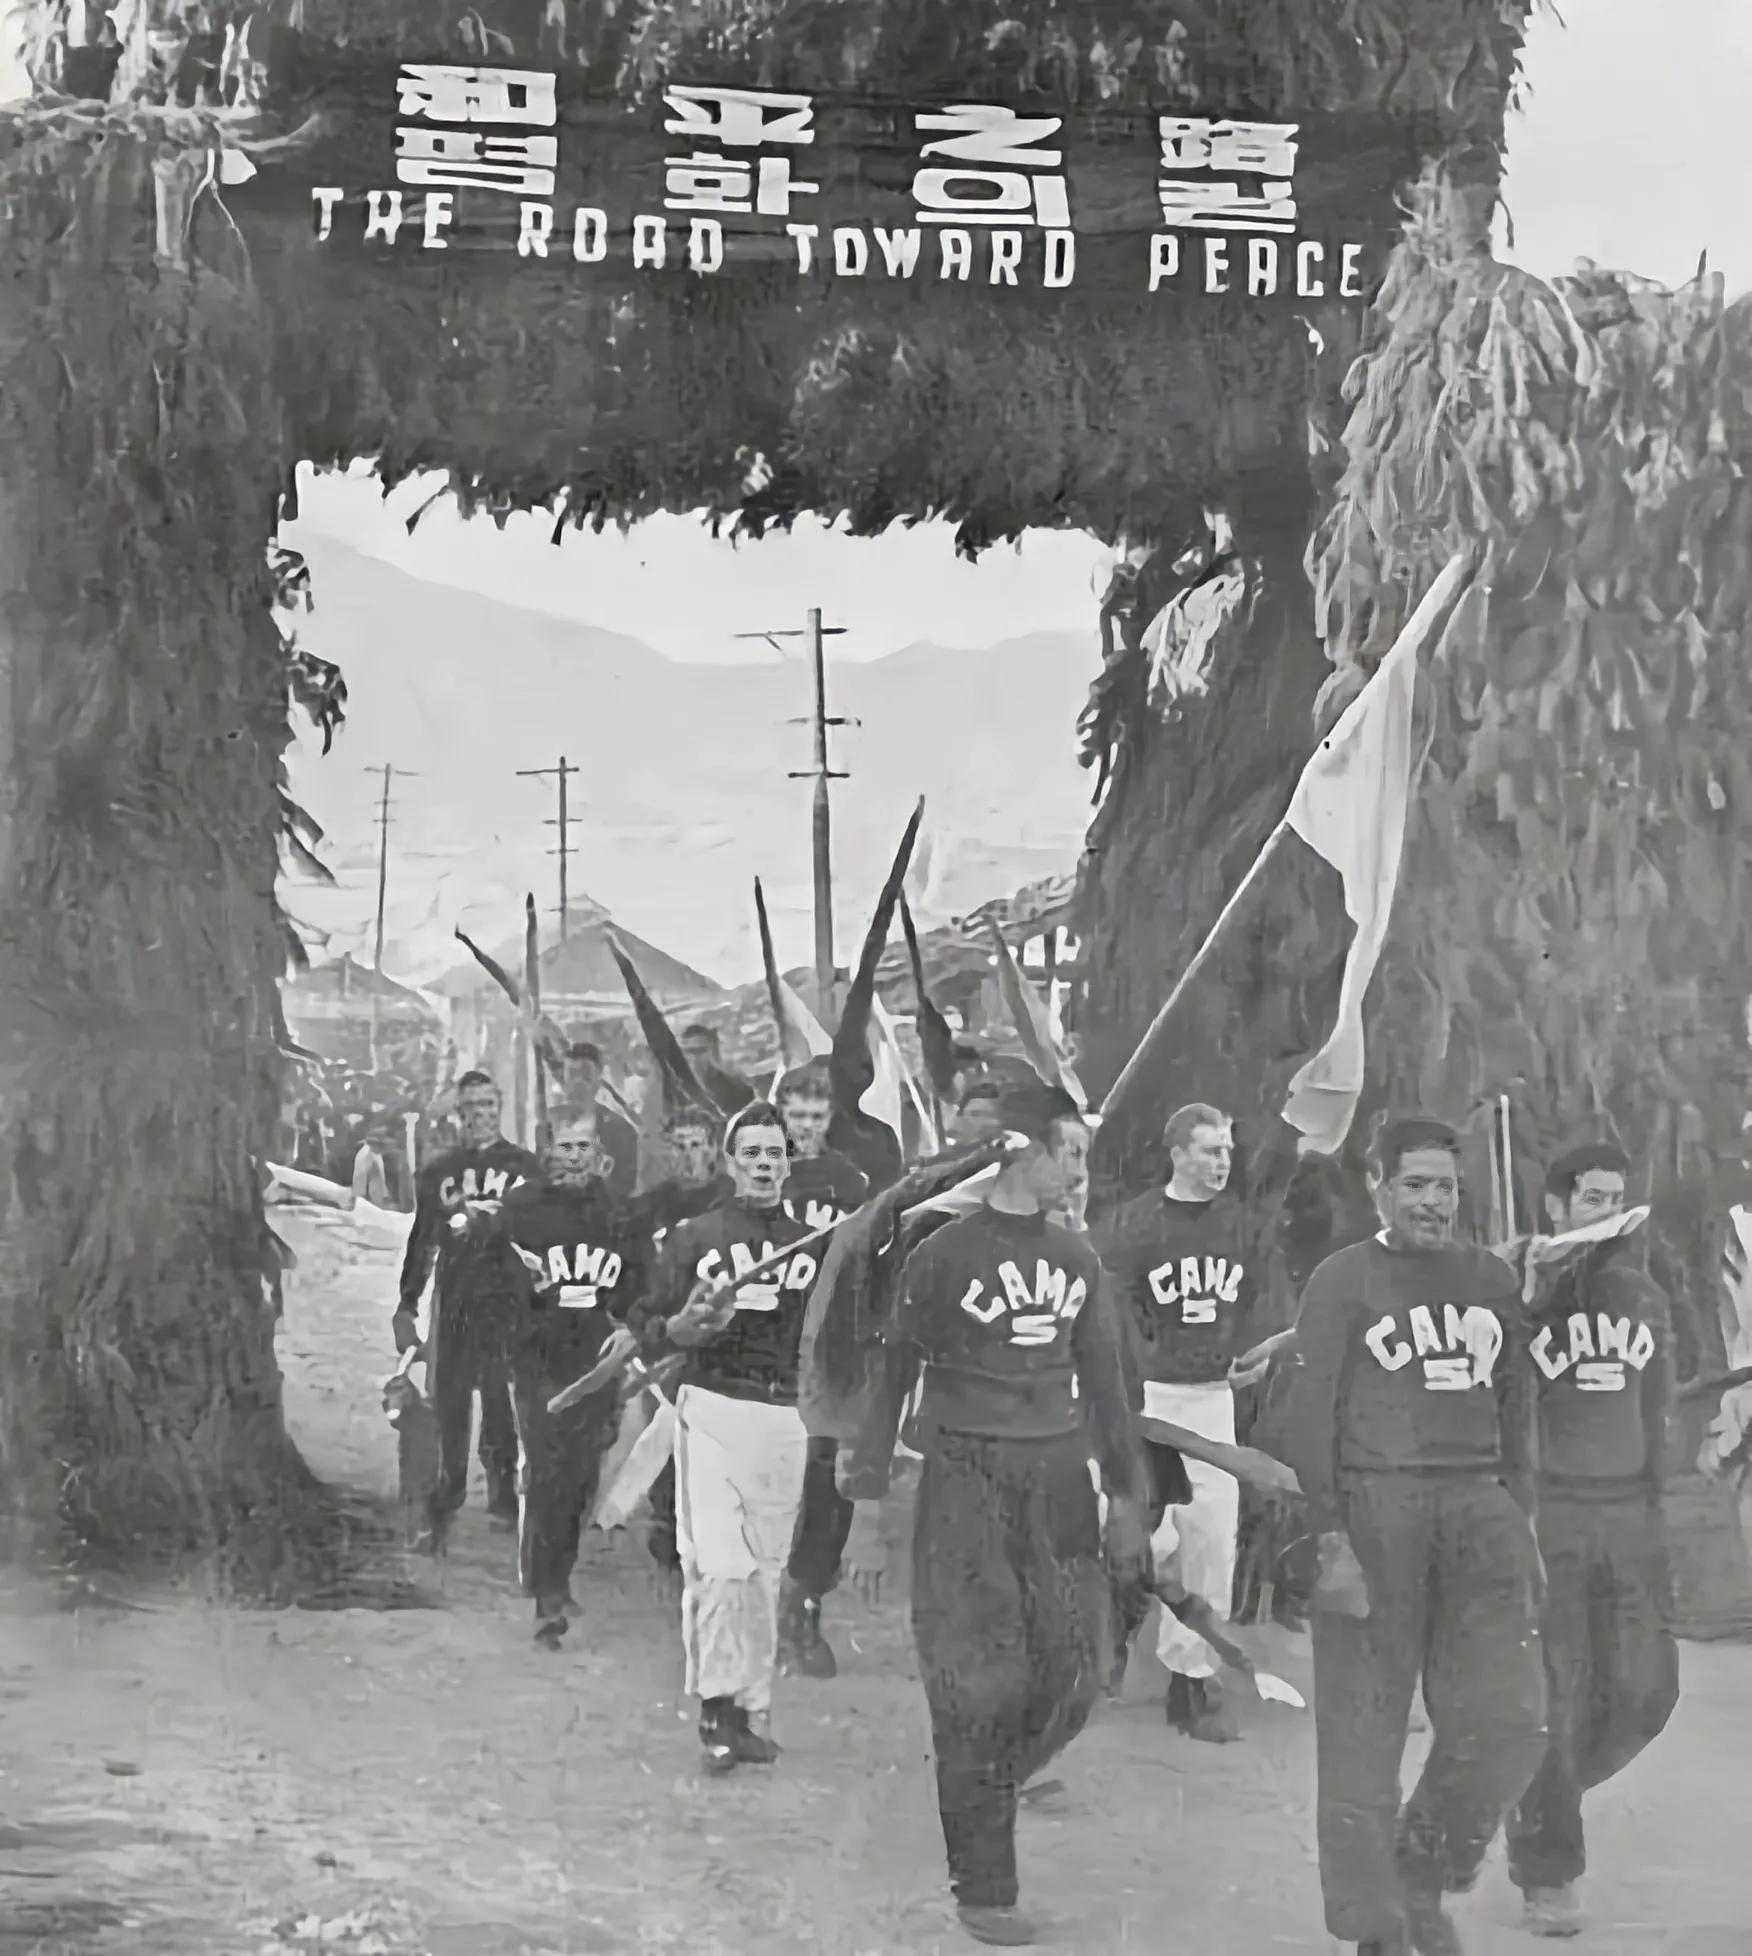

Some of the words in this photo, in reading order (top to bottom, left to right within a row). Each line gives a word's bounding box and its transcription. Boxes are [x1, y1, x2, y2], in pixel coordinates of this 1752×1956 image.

[311, 187, 453, 248] THE
[517, 201, 724, 274] ROAD
[787, 224, 1075, 288] TOWARD
[1149, 234, 1364, 297] PEACE
